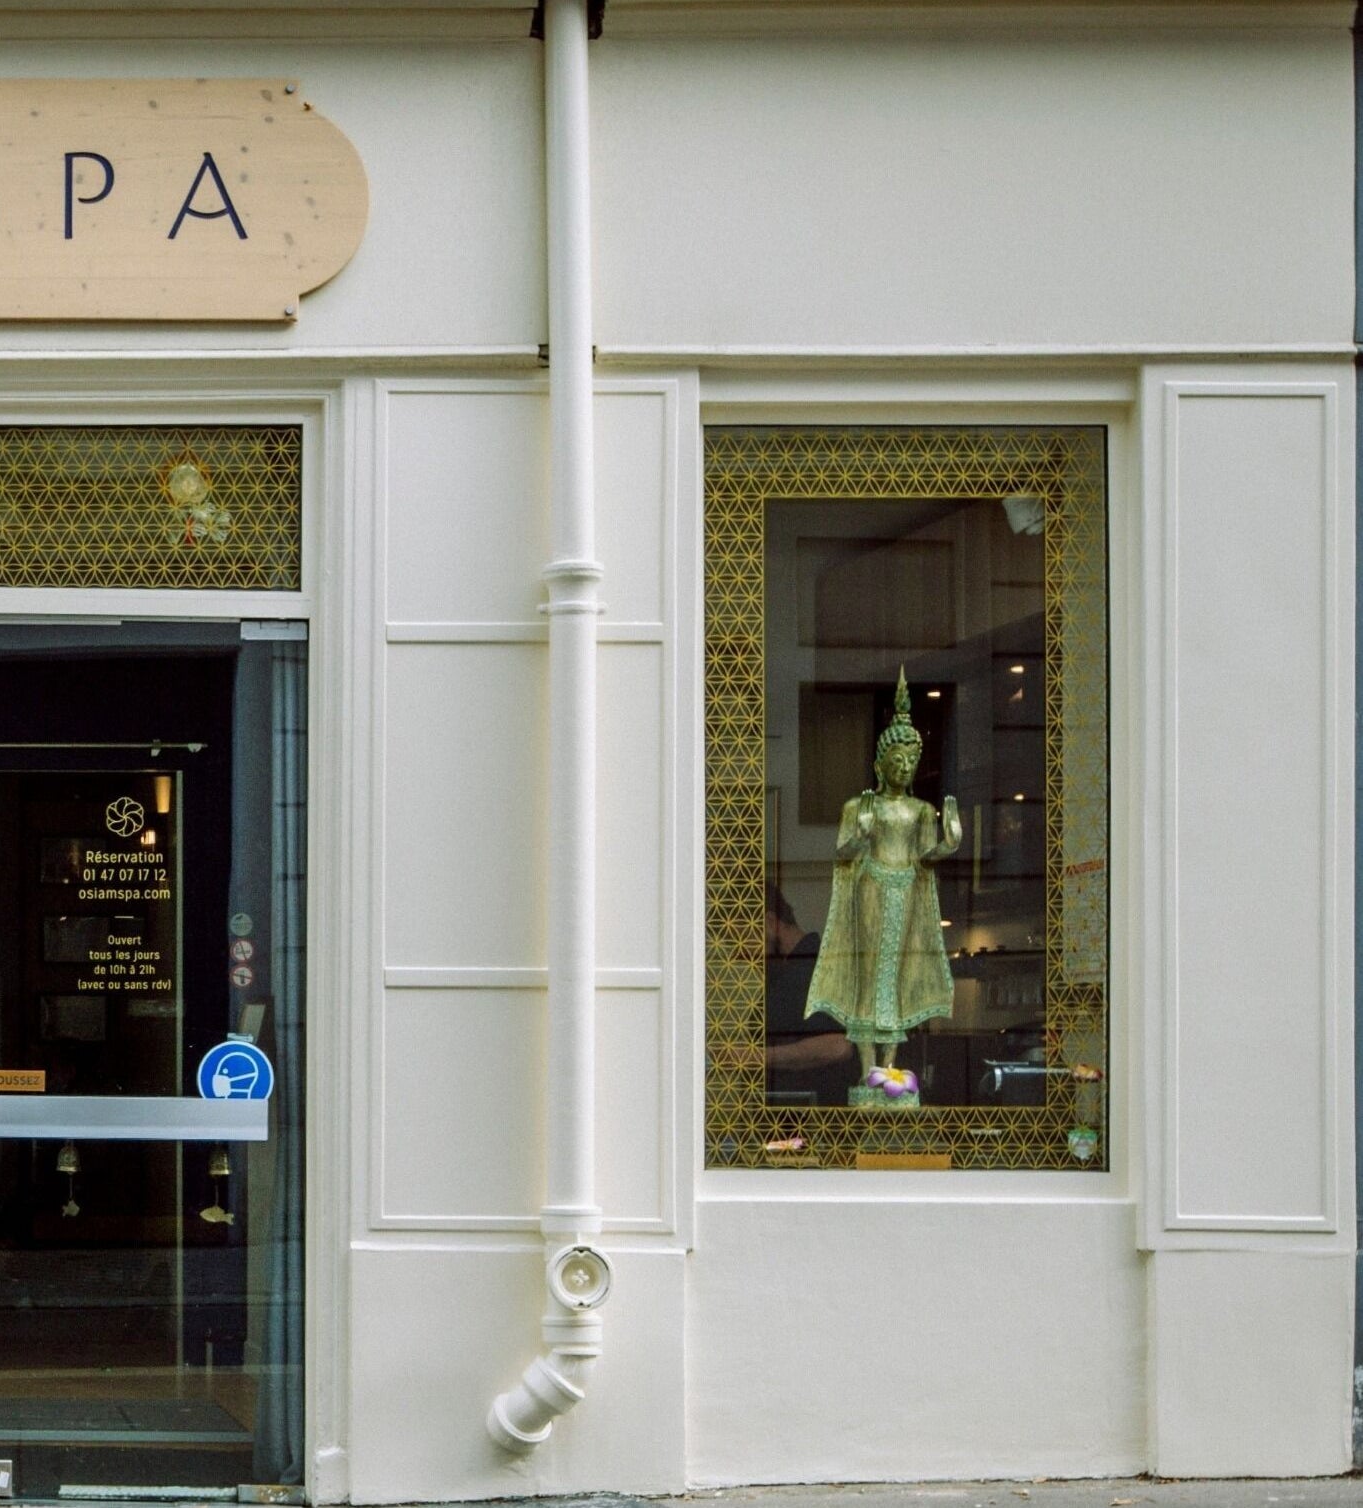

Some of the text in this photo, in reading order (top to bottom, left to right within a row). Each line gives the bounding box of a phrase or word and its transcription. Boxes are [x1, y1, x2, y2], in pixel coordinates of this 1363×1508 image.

[86, 850, 164, 863] Réservation
[83, 868, 167, 881] 01 47 07 17 12
[78, 887, 171, 902] osiamspa.com
[107, 934, 142, 945] Ouvert
[89, 950, 161, 963] tous les jours
[93, 964, 156, 975] de 10h à 21h
[77, 978, 172, 990] (avec ou sans rdv)
